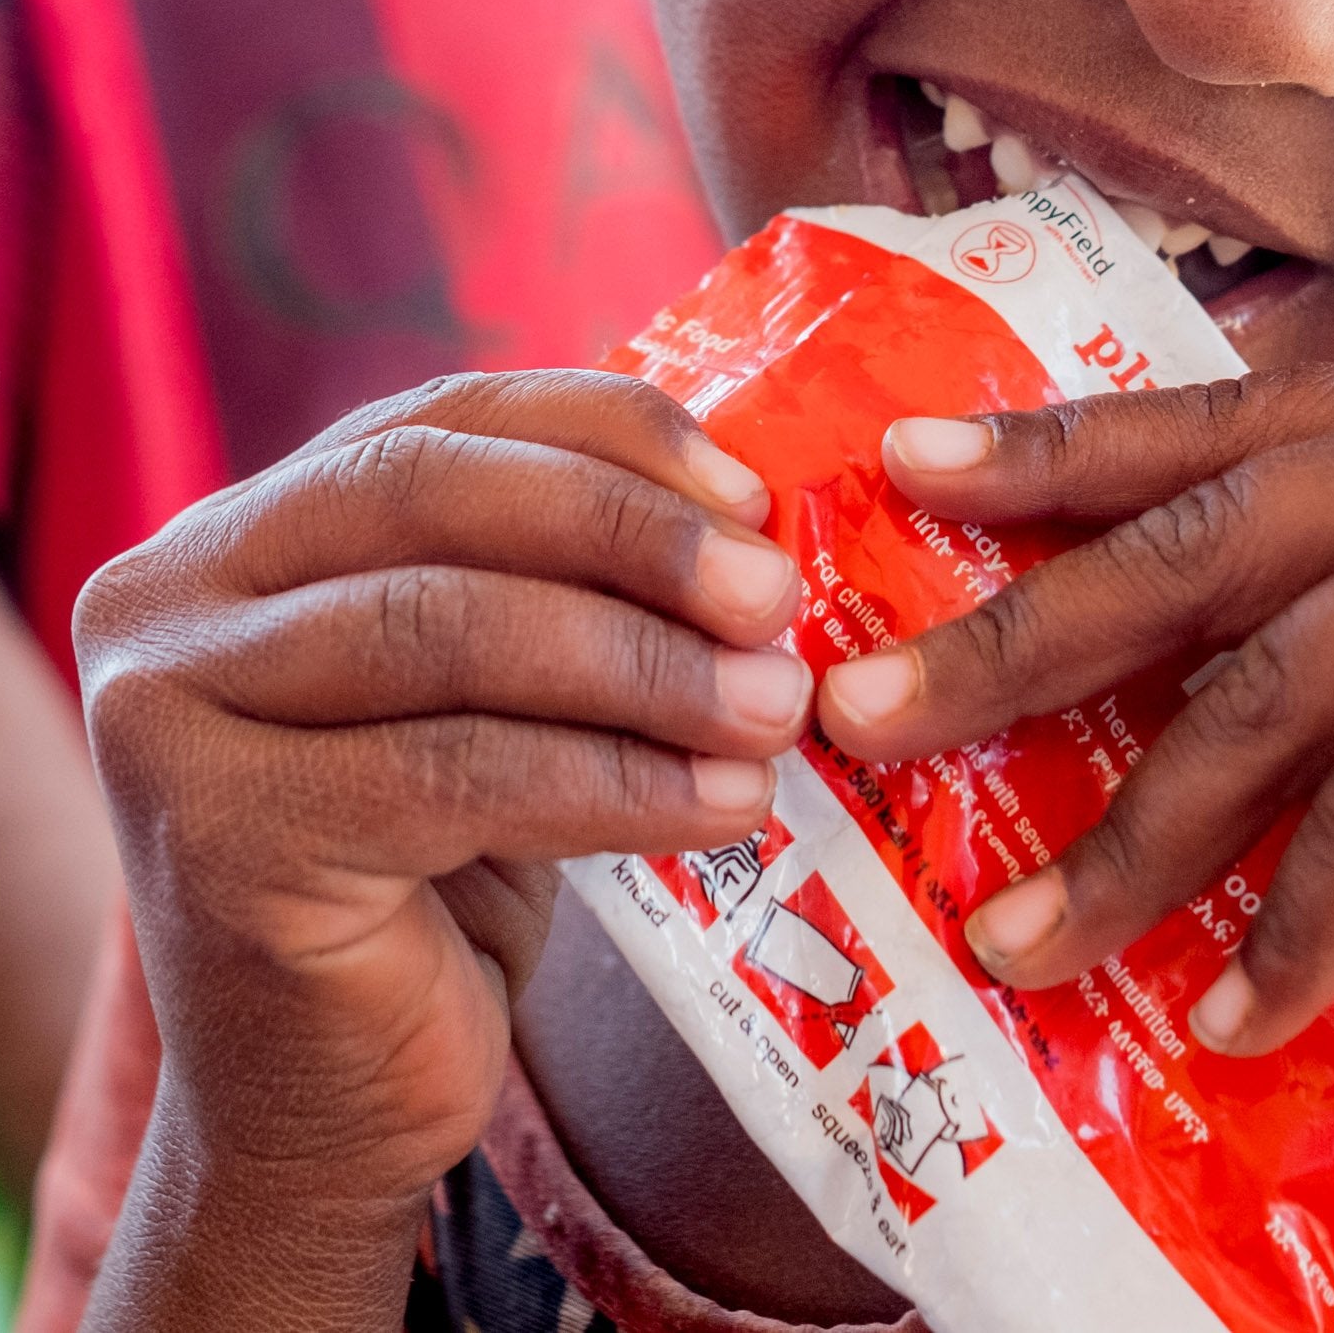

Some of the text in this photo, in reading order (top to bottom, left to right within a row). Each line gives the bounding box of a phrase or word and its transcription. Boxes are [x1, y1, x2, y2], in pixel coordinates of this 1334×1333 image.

[674, 319, 741, 353] Food
[1073, 322, 1158, 392] pl
[812, 551, 844, 588] For
[847, 767, 885, 809] 500
[983, 769, 1020, 818] with
[1014, 816, 1052, 867] seve
[611, 859, 670, 928] knead
[709, 979, 800, 1089] cut & open
[811, 1102, 873, 1192] squeeze
[878, 1217, 907, 1257] eat
